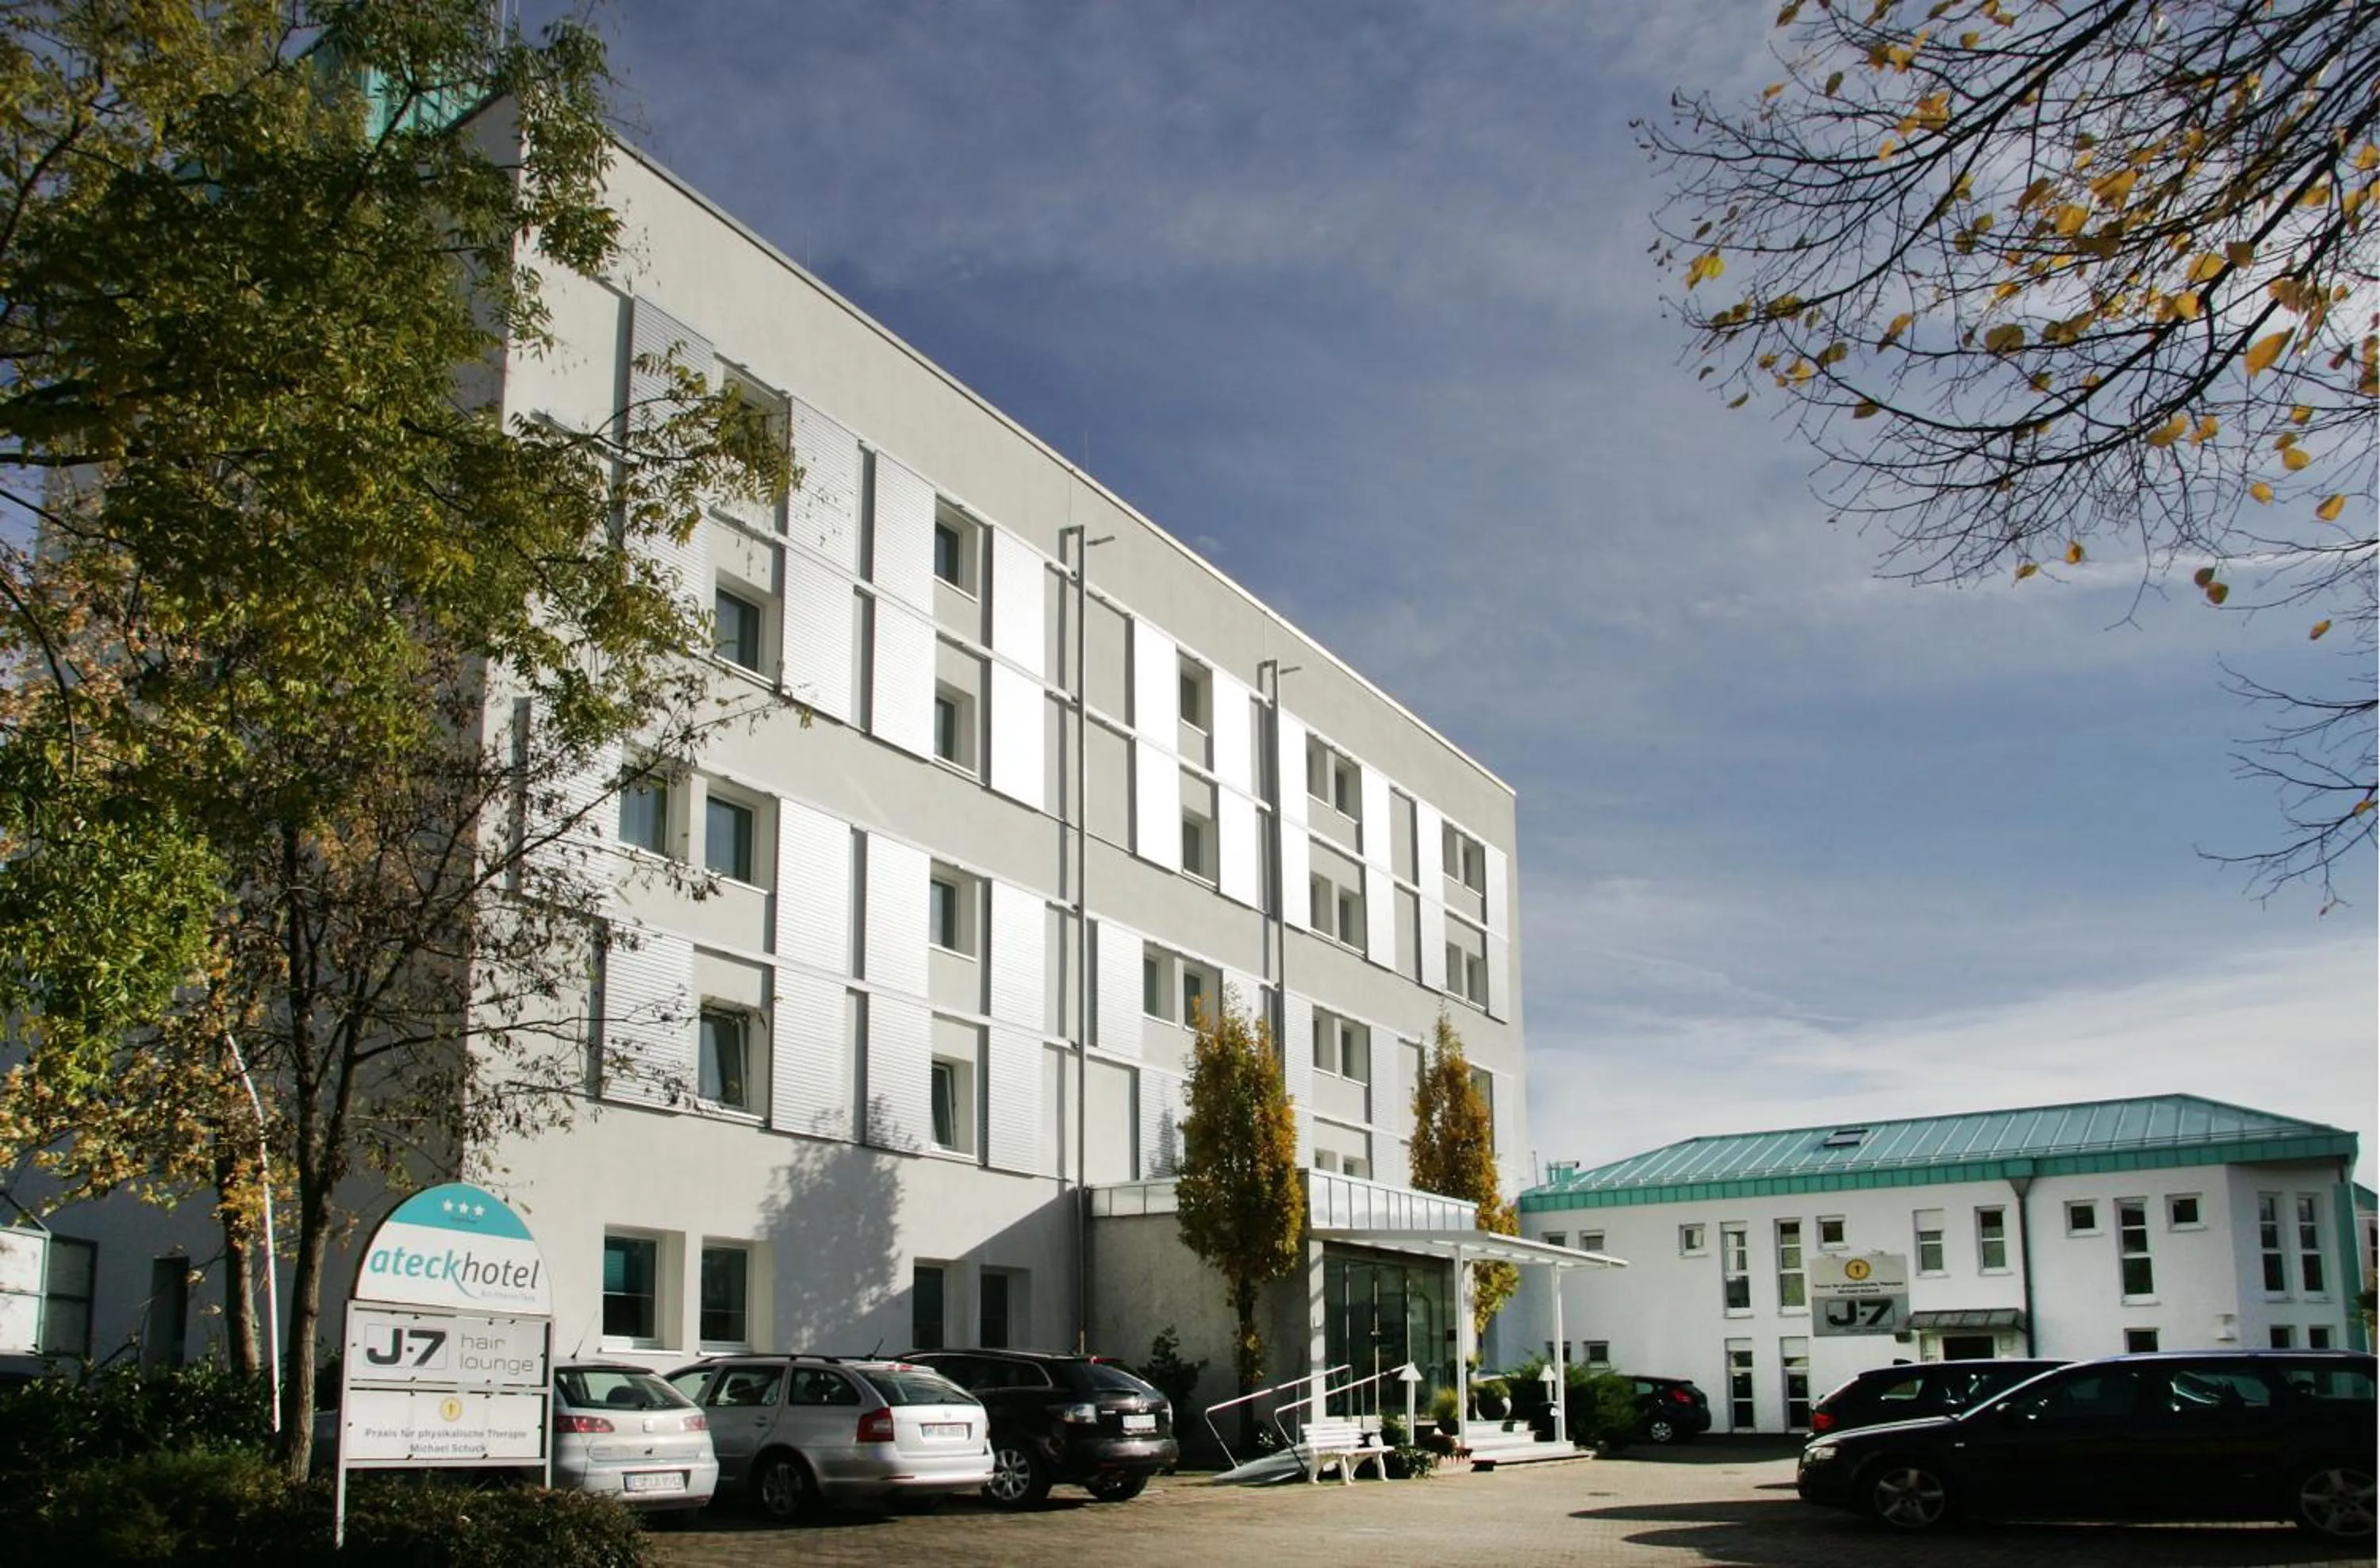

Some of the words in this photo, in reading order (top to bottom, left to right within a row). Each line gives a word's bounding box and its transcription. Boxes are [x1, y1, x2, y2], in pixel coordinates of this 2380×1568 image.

[370, 1247, 539, 1289] ateckhotel
[460, 1332, 506, 1350] hair
[459, 1352, 534, 1375] lounge
[365, 1428, 396, 1438] Praxis
[487, 1429, 528, 1439] Therapie
[410, 1443, 449, 1453] Michael
